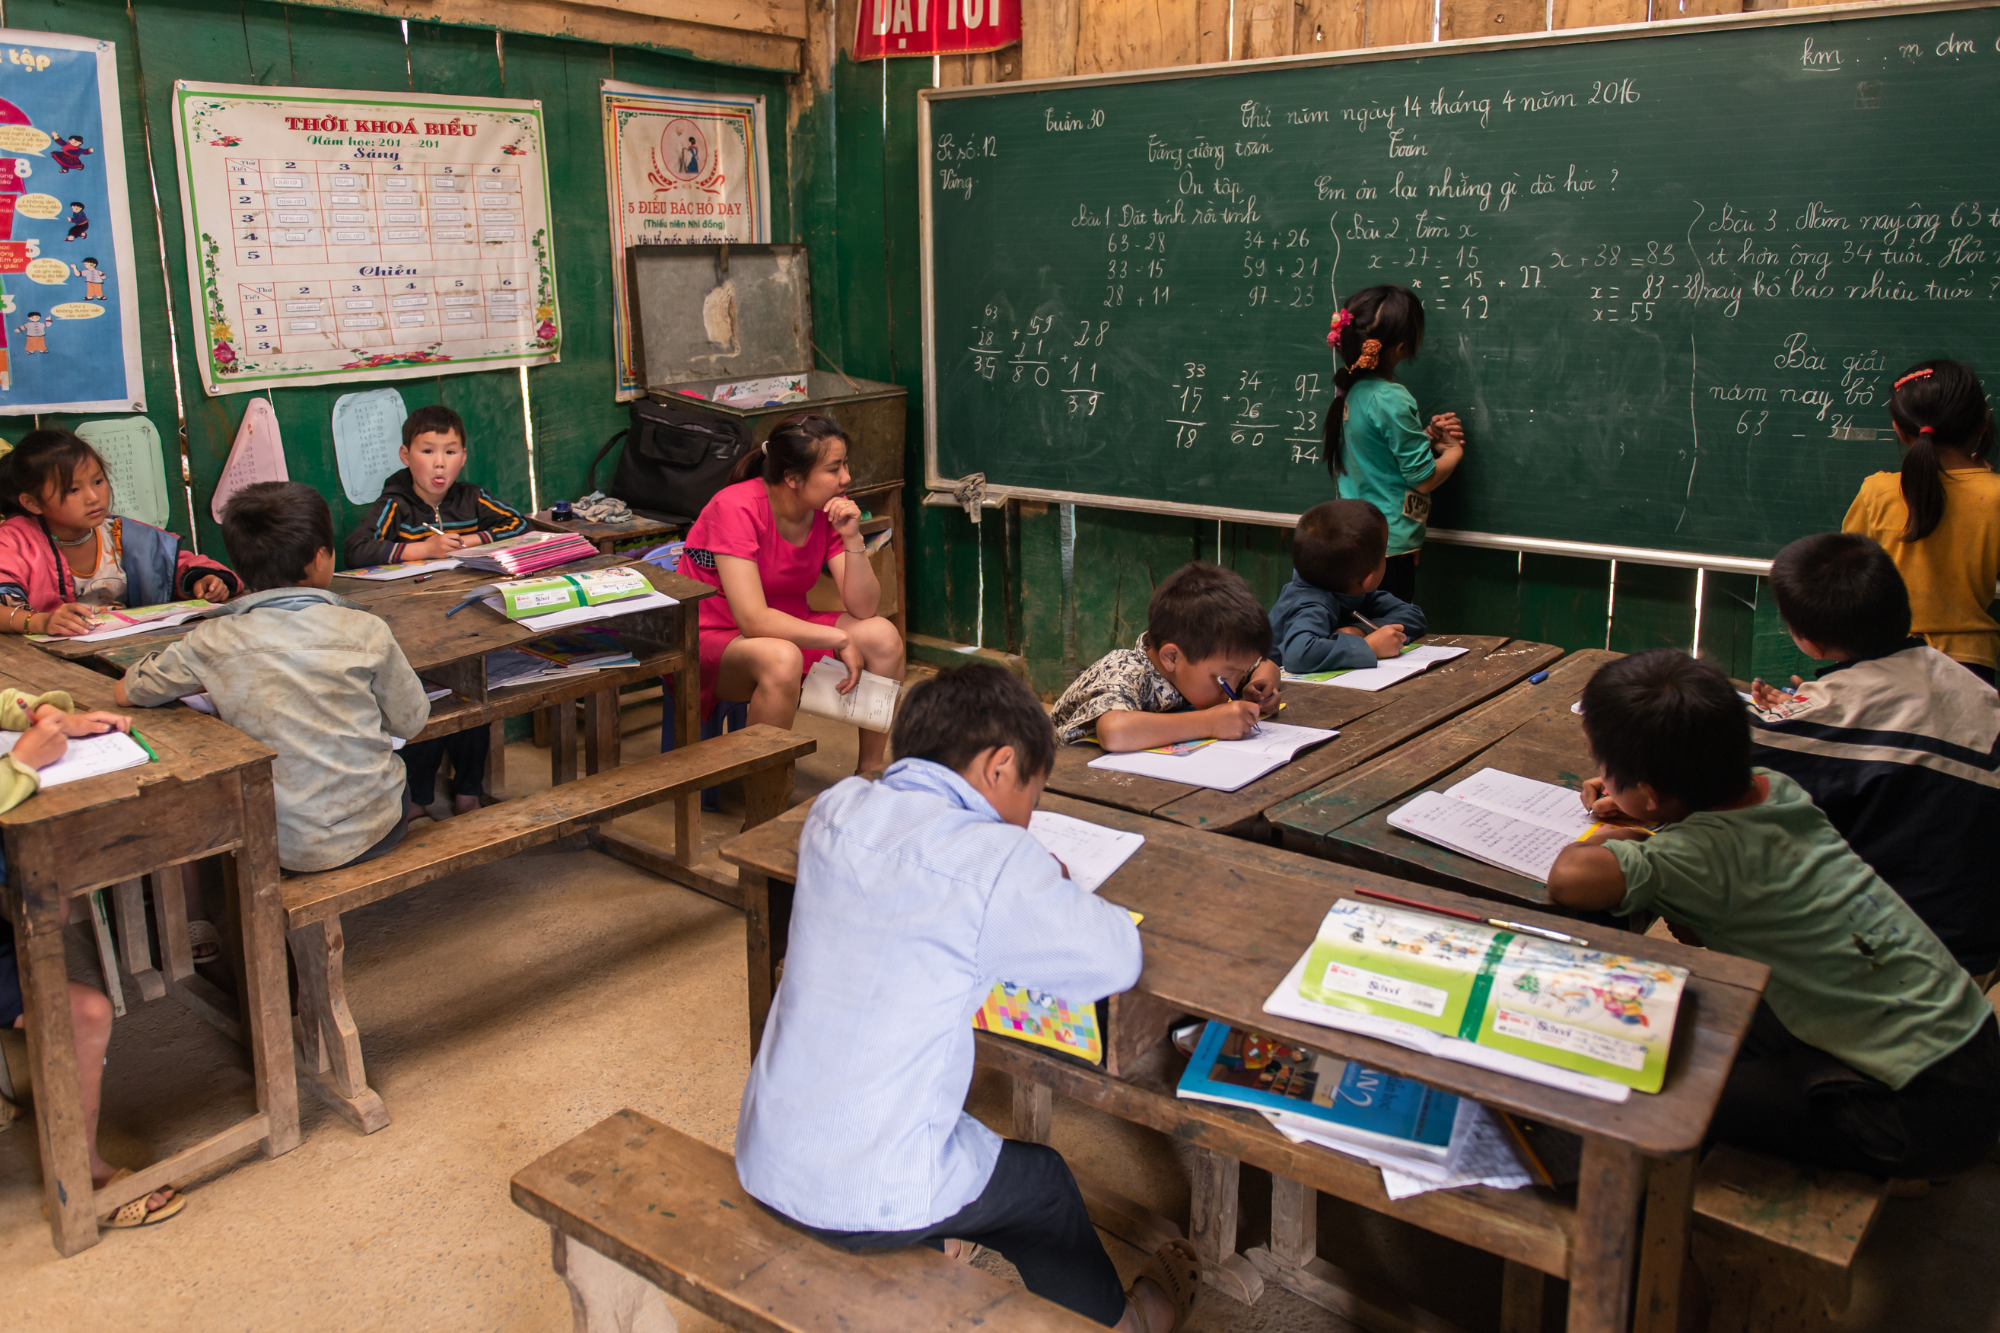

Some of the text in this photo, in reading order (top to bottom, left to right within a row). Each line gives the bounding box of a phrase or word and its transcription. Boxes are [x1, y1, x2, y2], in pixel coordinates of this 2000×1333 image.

[9, 48, 51, 72] tập
[1800, 37, 1844, 66] km
[1936, 33, 1977, 57] dm
[1341, 101, 1396, 132] ngày
[1404, 95, 1422, 117] 14
[1430, 87, 1490, 128] tháng
[1502, 90, 1516, 112] 4
[1520, 91, 1578, 111] năm
[1587, 77, 1641, 104] 2016
[285, 115, 477, 136] THỜI KHOÁ BIỂU
[1086, 109, 1106, 129] 30
[307, 135, 439, 149] Năm học: 201 201
[353, 147, 399, 161] Sáng
[14, 158, 32, 178] 8
[339, 163, 350, 171] 3
[237, 178, 248, 186] 1
[1179, 163, 1204, 194] Ôn
[1314, 176, 1347, 200] Em
[1356, 179, 1377, 199] ôn
[1390, 171, 1418, 199] lại
[1428, 167, 1492, 211] những
[1499, 172, 1521, 211] gì
[1531, 174, 1556, 194] đã
[1610, 168, 1619, 191] ?
[239, 196, 251, 204] 2
[628, 202, 635, 213] 5
[670, 198, 694, 214] BÁC
[717, 203, 742, 218] DẠY
[1220, 195, 1260, 224] tính
[242, 214, 254, 222] 3
[669, 220, 685, 228] niên
[688, 220, 700, 228] Nhi
[1796, 201, 1850, 230] Năm
[1860, 214, 1905, 246] nay
[1907, 202, 1940, 244] ông
[1951, 202, 1981, 228] 63
[1108, 232, 1165, 253] 63 28
[1244, 228, 1309, 249] 34 26
[1458, 225, 1478, 239] x
[25, 239, 40, 258] 5
[247, 251, 260, 260] 5
[1404, 246, 1478, 268] 27 15
[1595, 241, 1674, 266] 38 83
[359, 264, 417, 277] Chiều
[1107, 258, 1166, 279] 33 15
[1243, 256, 1318, 278] 59 21
[1790, 243, 1833, 281] ông
[1842, 240, 1873, 265] 34
[1464, 271, 1483, 288] 15
[1642, 272, 1701, 299] 83 38
[1103, 285, 1169, 307] 28 11
[1249, 286, 1314, 307] 97 23
[1704, 285, 1742, 318] nay
[1752, 268, 1790, 298] bố
[1790, 268, 1833, 298] bao
[1844, 268, 1919, 302] nhiêu
[1, 295, 16, 313] 3
[253, 307, 265, 315] 1
[985, 304, 998, 320] 63
[1631, 302, 1655, 322] 55
[255, 324, 267, 332] 2
[258, 342, 270, 350] 3
[1774, 332, 1885, 387] Bài giải
[1184, 362, 1206, 379] 33
[1239, 370, 1262, 391] 34
[1295, 373, 1321, 402] 97
[1180, 386, 1204, 413] 15
[1780, 376, 1881, 421] nay bố
[1293, 410, 1317, 431] 23
[1737, 410, 1854, 440] 63 34
[1176, 425, 1197, 448] 18
